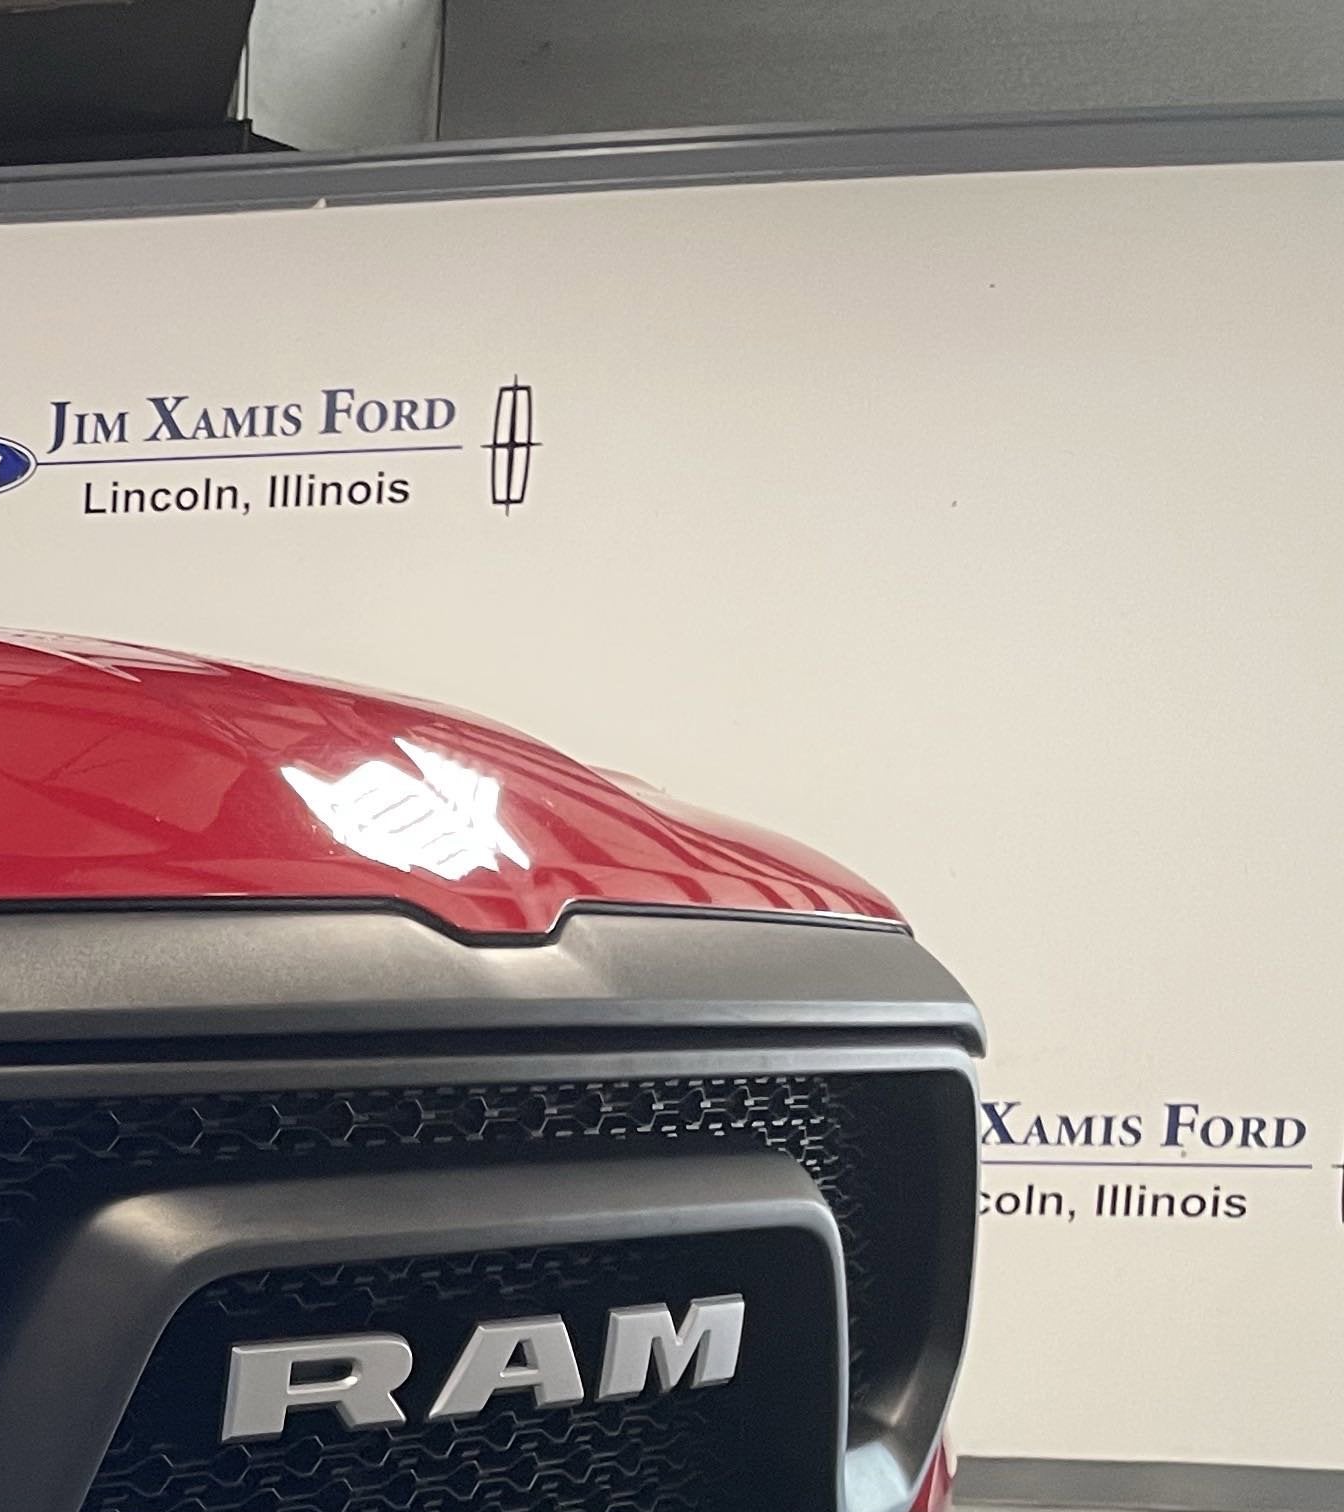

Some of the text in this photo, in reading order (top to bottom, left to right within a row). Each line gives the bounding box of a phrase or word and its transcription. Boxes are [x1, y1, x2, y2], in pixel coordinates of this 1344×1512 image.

[46, 387, 457, 454] JIM XAMIS FORD
[82, 470, 411, 516] Lincoln, Illinois
[979, 1100, 1307, 1150] XAMIS FORD
[1095, 1184, 1248, 1219] Illinois
[220, 1292, 746, 1445] RAM
